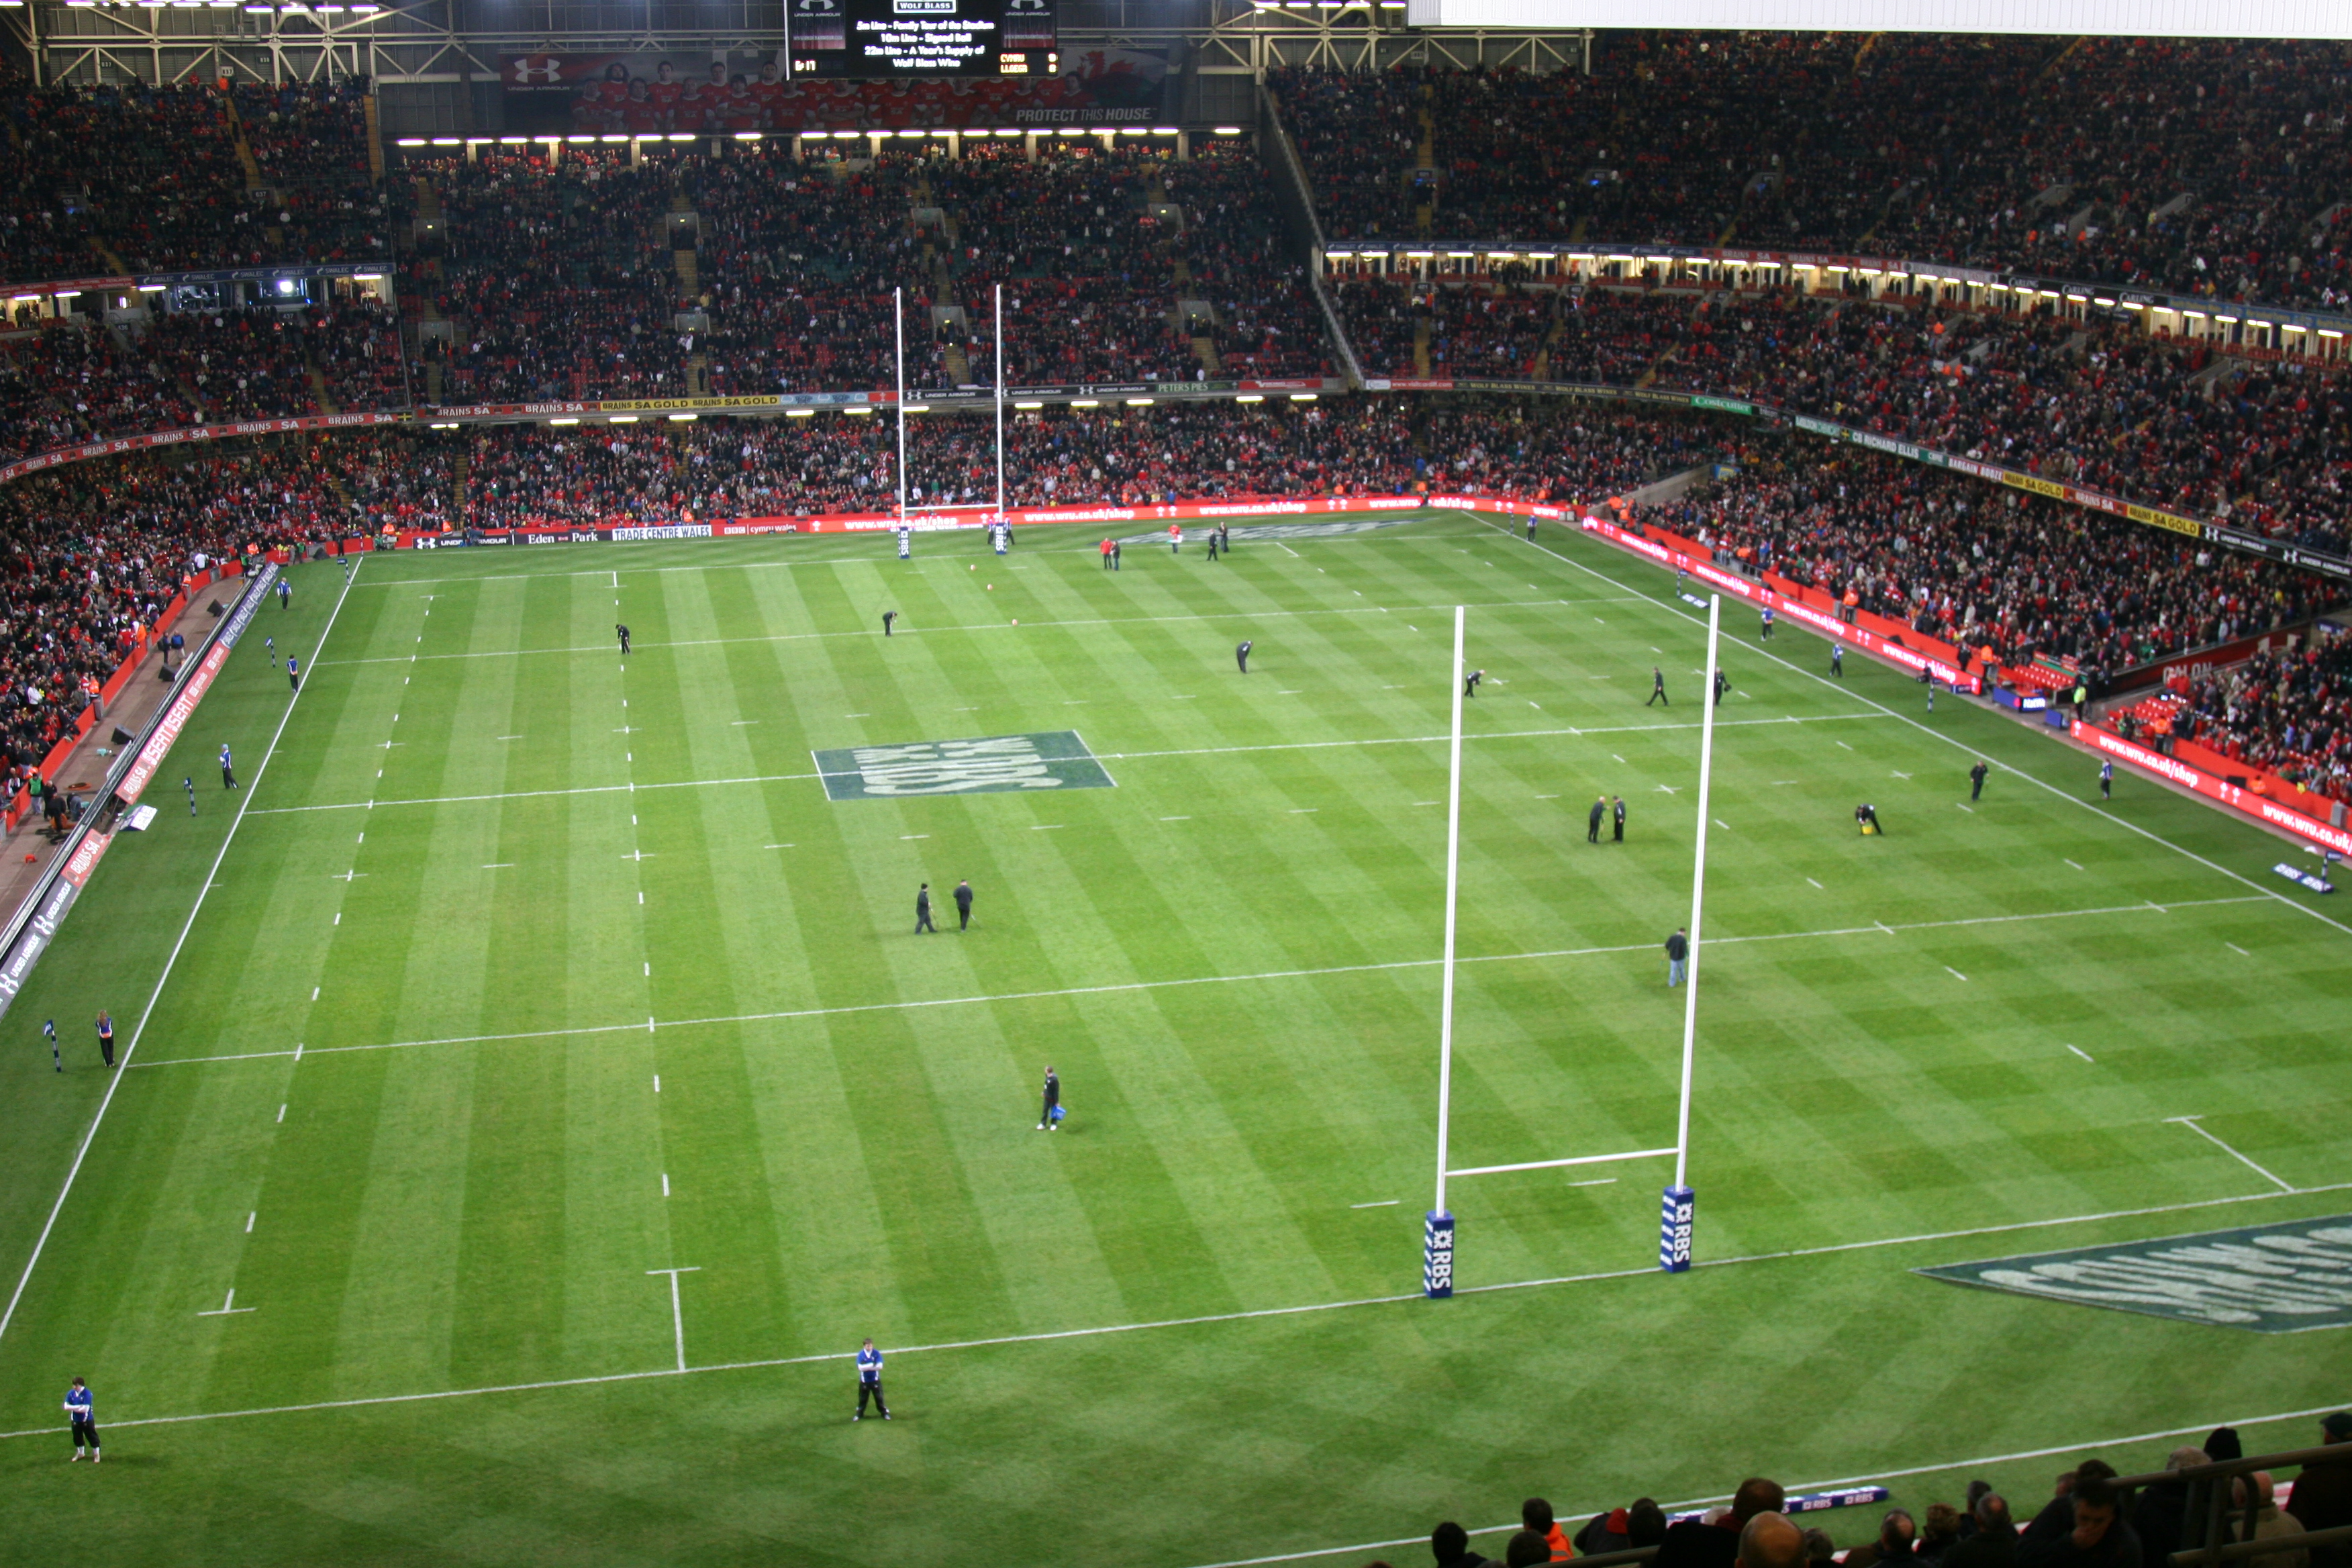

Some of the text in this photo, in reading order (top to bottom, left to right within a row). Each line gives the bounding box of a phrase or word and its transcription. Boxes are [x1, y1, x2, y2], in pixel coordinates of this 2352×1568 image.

[871, 21, 887, 30] Line
[893, 21, 919, 32] Family
[920, 20, 937, 30] Tour
[938, 20, 948, 30] of
[948, 21, 961, 30] the
[963, 20, 995, 30] Stadium
[881, 33, 972, 44] 10m Line Signed Ball
[865, 45, 985, 56] 22m Line A Year's Supply of
[893, 58, 961, 67] Wolf Blass Wine
[1000, 53, 1025, 62] CYMRU
[1000, 64, 1028, 73] LLOEGR
[1016, 109, 1077, 121] PROTECT
[1081, 109, 1103, 121] THIS
[1757, 252, 1771, 260] SA
[1159, 383, 1189, 391] PETERS
[1191, 383, 1208, 391] PIES
[526, 403, 583, 413] BRAINS SA
[693, 397, 777, 407] BRAINS SA GOLD
[437, 407, 490, 416] BRAINS SA
[328, 414, 393, 424] BRAINS SA
[237, 420, 299, 433] BRAINS SA
[152, 430, 209, 444] BRAINS SA
[83, 440, 130, 456] BRAINS SA
[1853, 432, 1919, 459] CB RICHARD ELLIS
[26, 454, 62, 470] BRAINS SA
[6, 469, 15, 479] SA
[2024, 476, 2037, 489] SA
[2038, 479, 2063, 497] GOLD
[1199, 501, 1306, 514] www.wru.co.uk/shop
[2101, 497, 2114, 510] SA
[1024, 508, 1134, 521] www.wru.co.uk/shop
[724, 526, 746, 535] BBC
[2153, 514, 2166, 524] SA
[2168, 518, 2196, 534] GOLD
[528, 532, 598, 544] Eden Park
[615, 526, 709, 540] TRADE CENTRE WALES
[901, 539, 909, 555] RBS
[995, 535, 1004, 551] RBS
[1620, 533, 1668, 561] www.wru.co.uk/shop
[1696, 565, 1750, 595] www.wru.co.uk/shop
[1783, 601, 1845, 636] www.wru.co.uk/shop
[168, 693, 193, 728] SEAT
[148, 728, 173, 761] SEAT
[2099, 735, 2198, 788] www.wru.co.uk/shop
[124, 766, 148, 795] BRAINS SA
[70, 840, 100, 875] BRAINS SA
[46, 881, 72, 920] UNDER ARMOUR
[10, 934, 41, 977] UNDER ARMOUR
[1673, 1224, 1692, 1263] RBS
[1431, 1251, 1452, 1289] RBS
[1814, 1498, 1832, 1508] RBS
[1855, 1493, 1875, 1502] RBS
